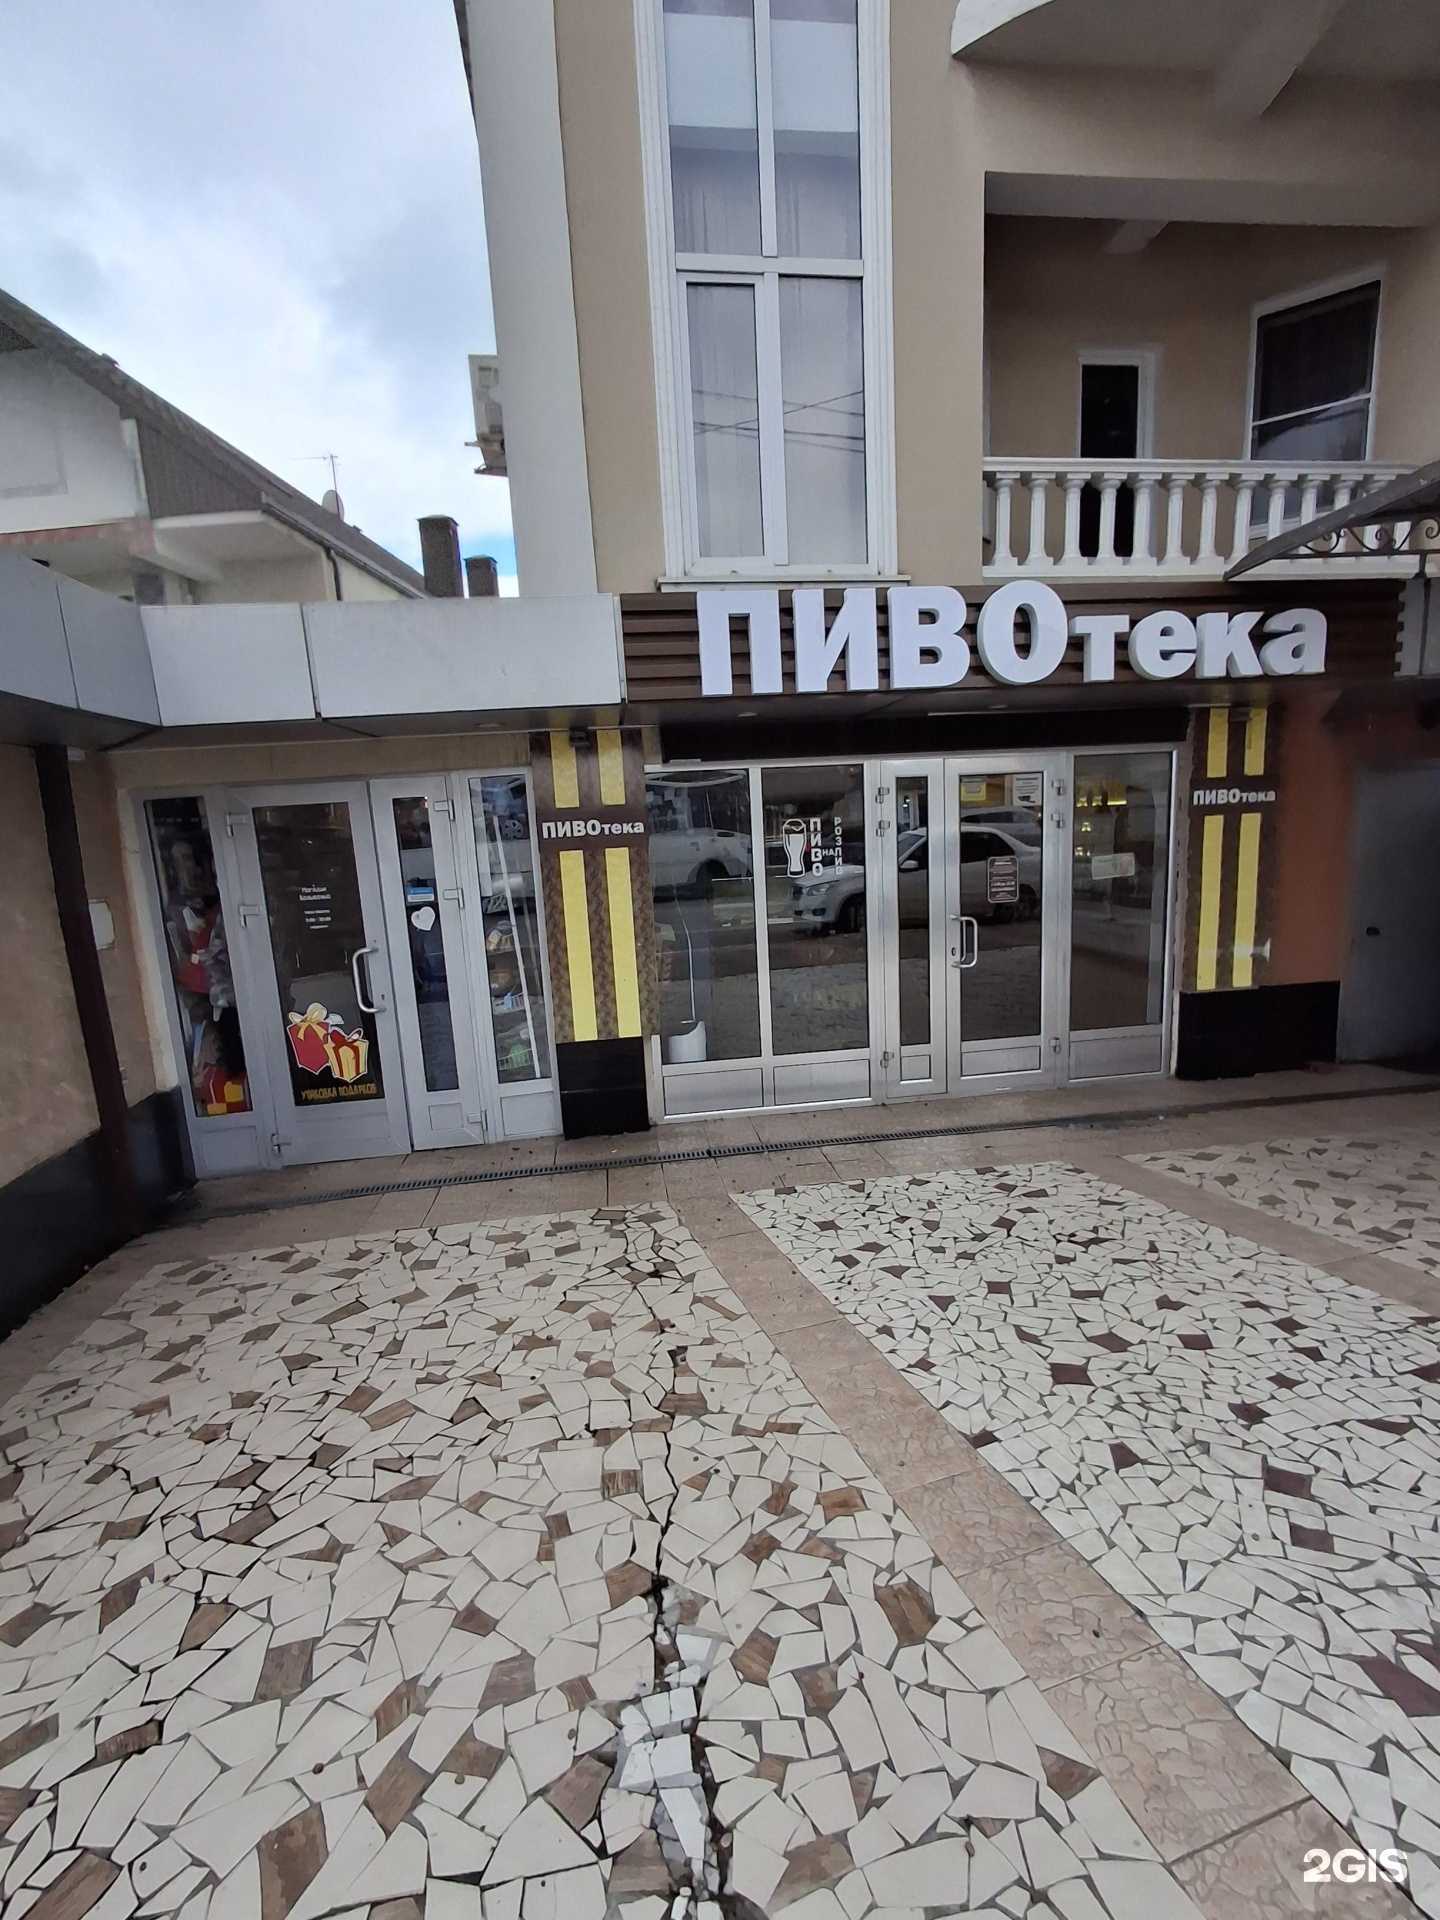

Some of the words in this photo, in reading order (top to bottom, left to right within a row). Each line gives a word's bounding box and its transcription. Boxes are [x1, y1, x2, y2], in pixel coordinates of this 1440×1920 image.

[696, 580, 1328, 697] ПИВОтека
[1193, 788, 1276, 806] ПИВОтека
[541, 819, 645, 839] ПИВОтека
[810, 817, 824, 877] ПИВО
[822, 848, 836, 857] НА
